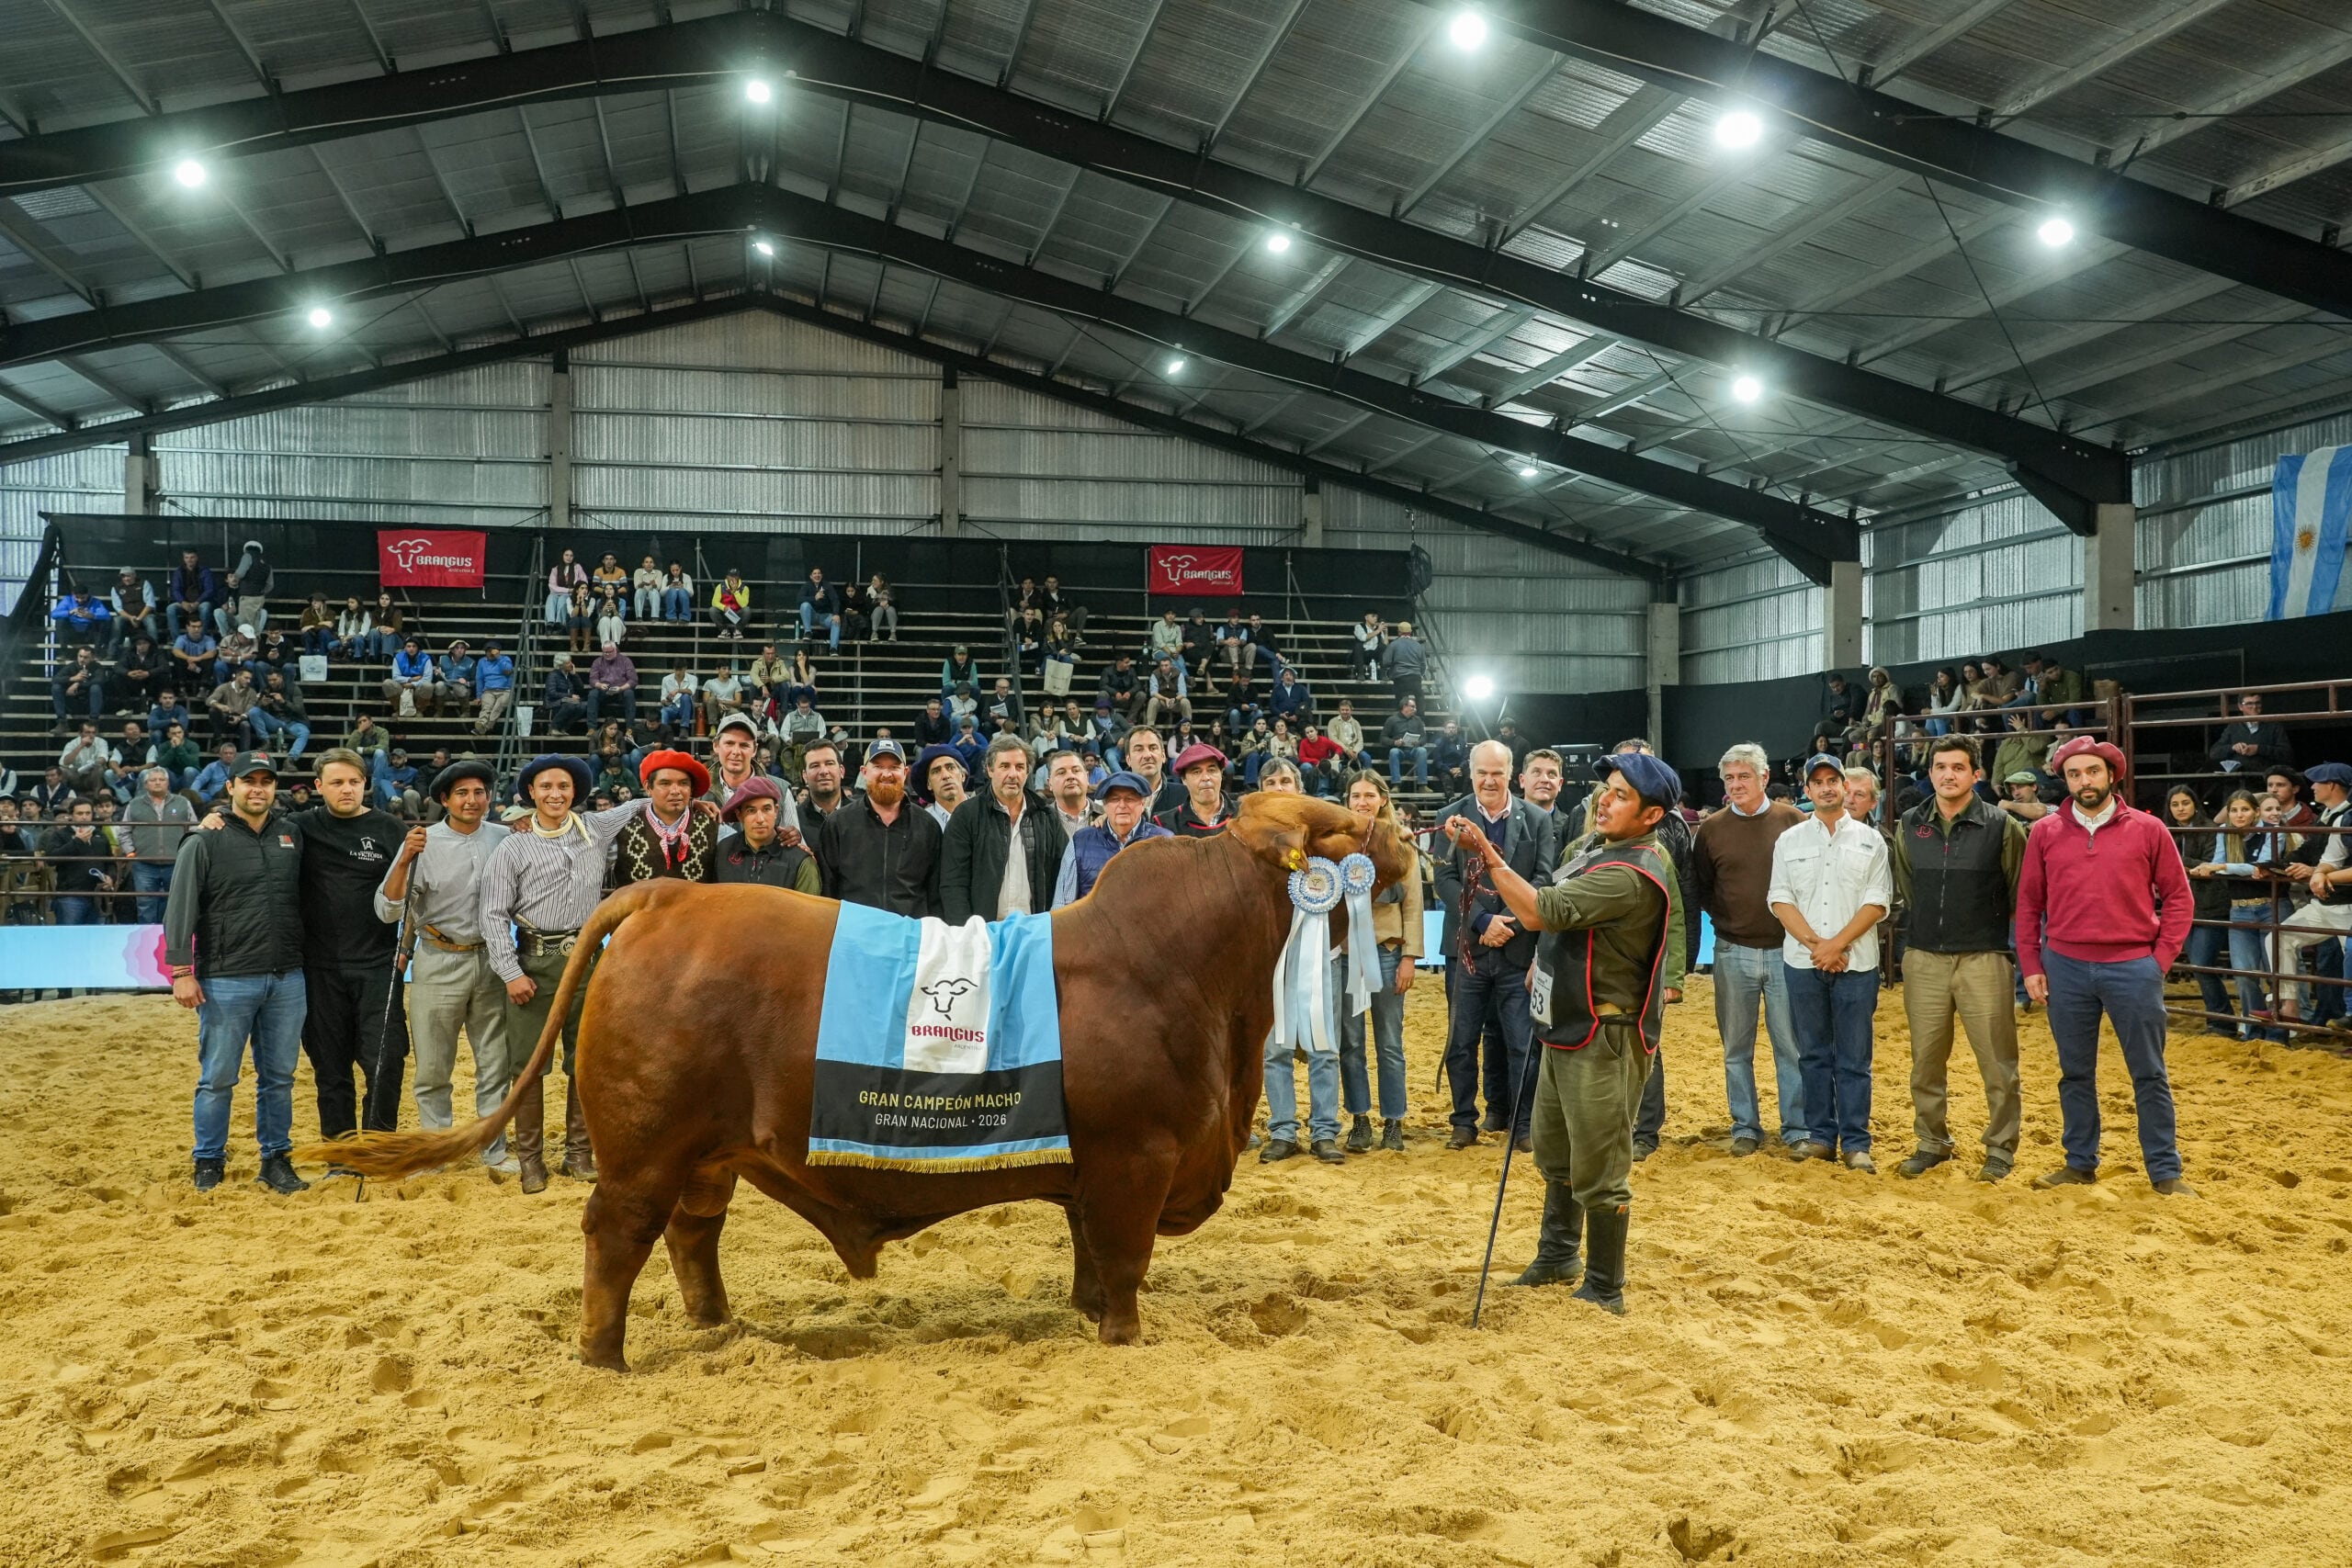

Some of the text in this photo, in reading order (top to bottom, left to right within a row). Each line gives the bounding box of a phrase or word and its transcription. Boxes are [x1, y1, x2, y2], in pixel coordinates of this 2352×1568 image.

[416, 555, 472, 568] BRANGUS
[1183, 570, 1232, 581] BRANGUS
[911, 1025, 985, 1043] BRANGUS
[859, 1090, 1022, 1111] GRAN CAMPEÓN MACHO
[875, 1112, 1007, 1130] GRAN NACIONAL 2026
